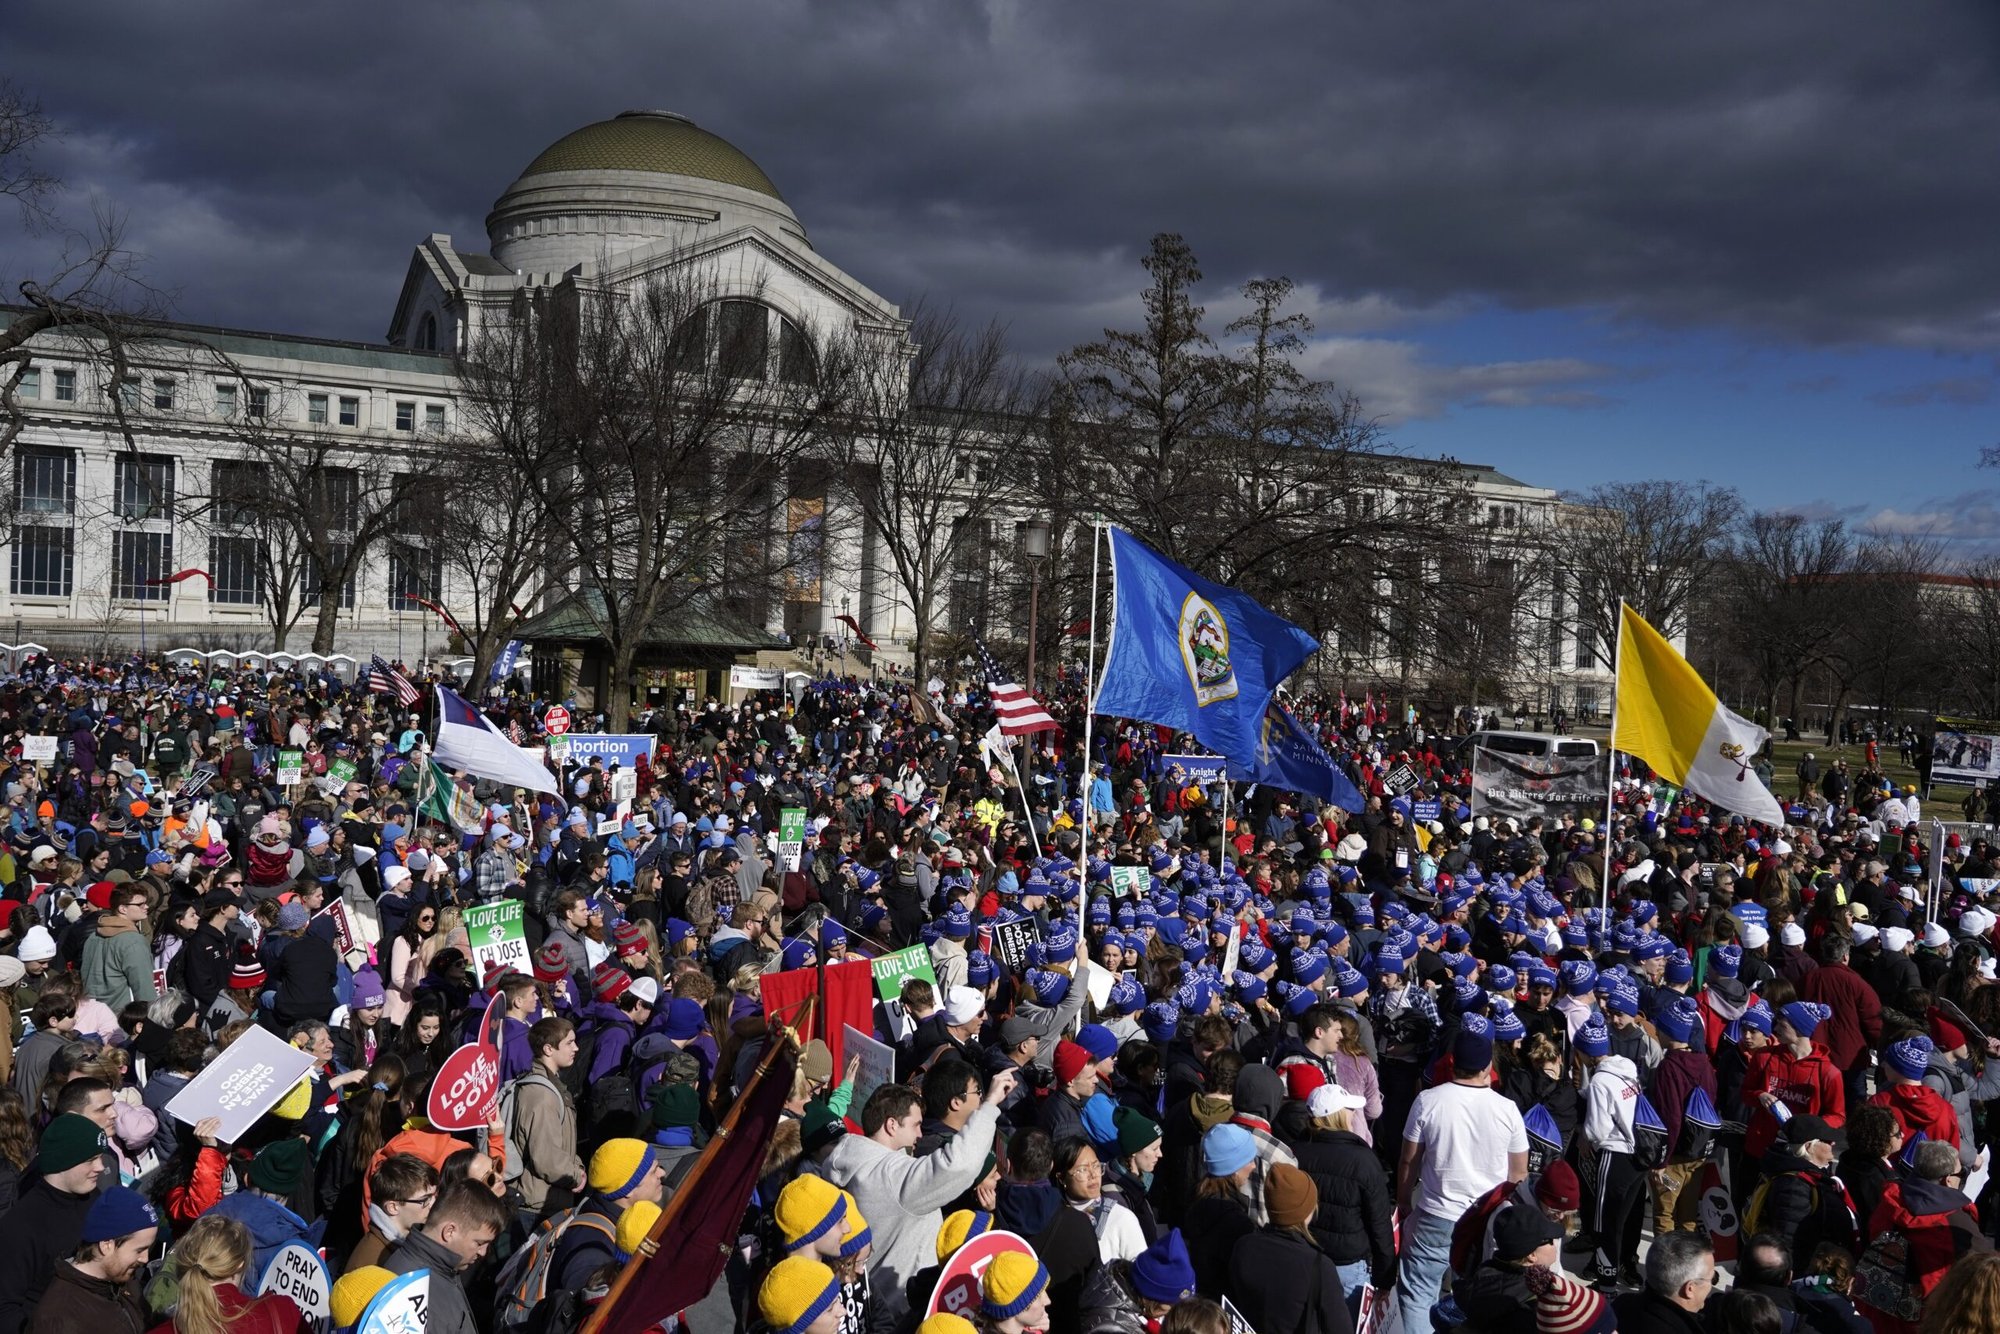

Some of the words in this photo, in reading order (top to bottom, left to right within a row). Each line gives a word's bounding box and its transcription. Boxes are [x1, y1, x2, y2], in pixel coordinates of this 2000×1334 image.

[498, 640, 517, 676] PEN
[547, 716, 568, 727] ABORTION
[552, 708, 563, 717] STOP
[562, 753, 592, 765] ake
[1293, 752, 1349, 779] MINNEAPO
[282, 768, 299, 776] CHOOSE
[1190, 767, 1217, 777] Knight
[1488, 788, 1505, 799] Pro
[1509, 789, 1543, 800] Bikers
[1570, 793, 1591, 803] Life
[601, 822, 619, 832] ABORTED
[793, 812, 805, 826] LIFE
[472, 909, 497, 928] LOVE
[500, 904, 521, 922] LIFE
[1004, 926, 1021, 972] GENERATIO
[875, 958, 904, 980] LOVE
[903, 947, 928, 970] LIFE
[218, 1063, 265, 1104] EMBRYO
[221, 1068, 247, 1090] TOO
[242, 1066, 274, 1094] ONCE
[441, 1052, 486, 1110] LOVE
[453, 1060, 498, 1121] BOTH
[223, 1094, 242, 1110] AN
[241, 1084, 270, 1106] WAS
[285, 1250, 318, 1281] PRAY
[1597, 1264, 1617, 1277] das
[276, 1267, 290, 1289] TO
[291, 1280, 319, 1306] END
[843, 1282, 859, 1334] POS
